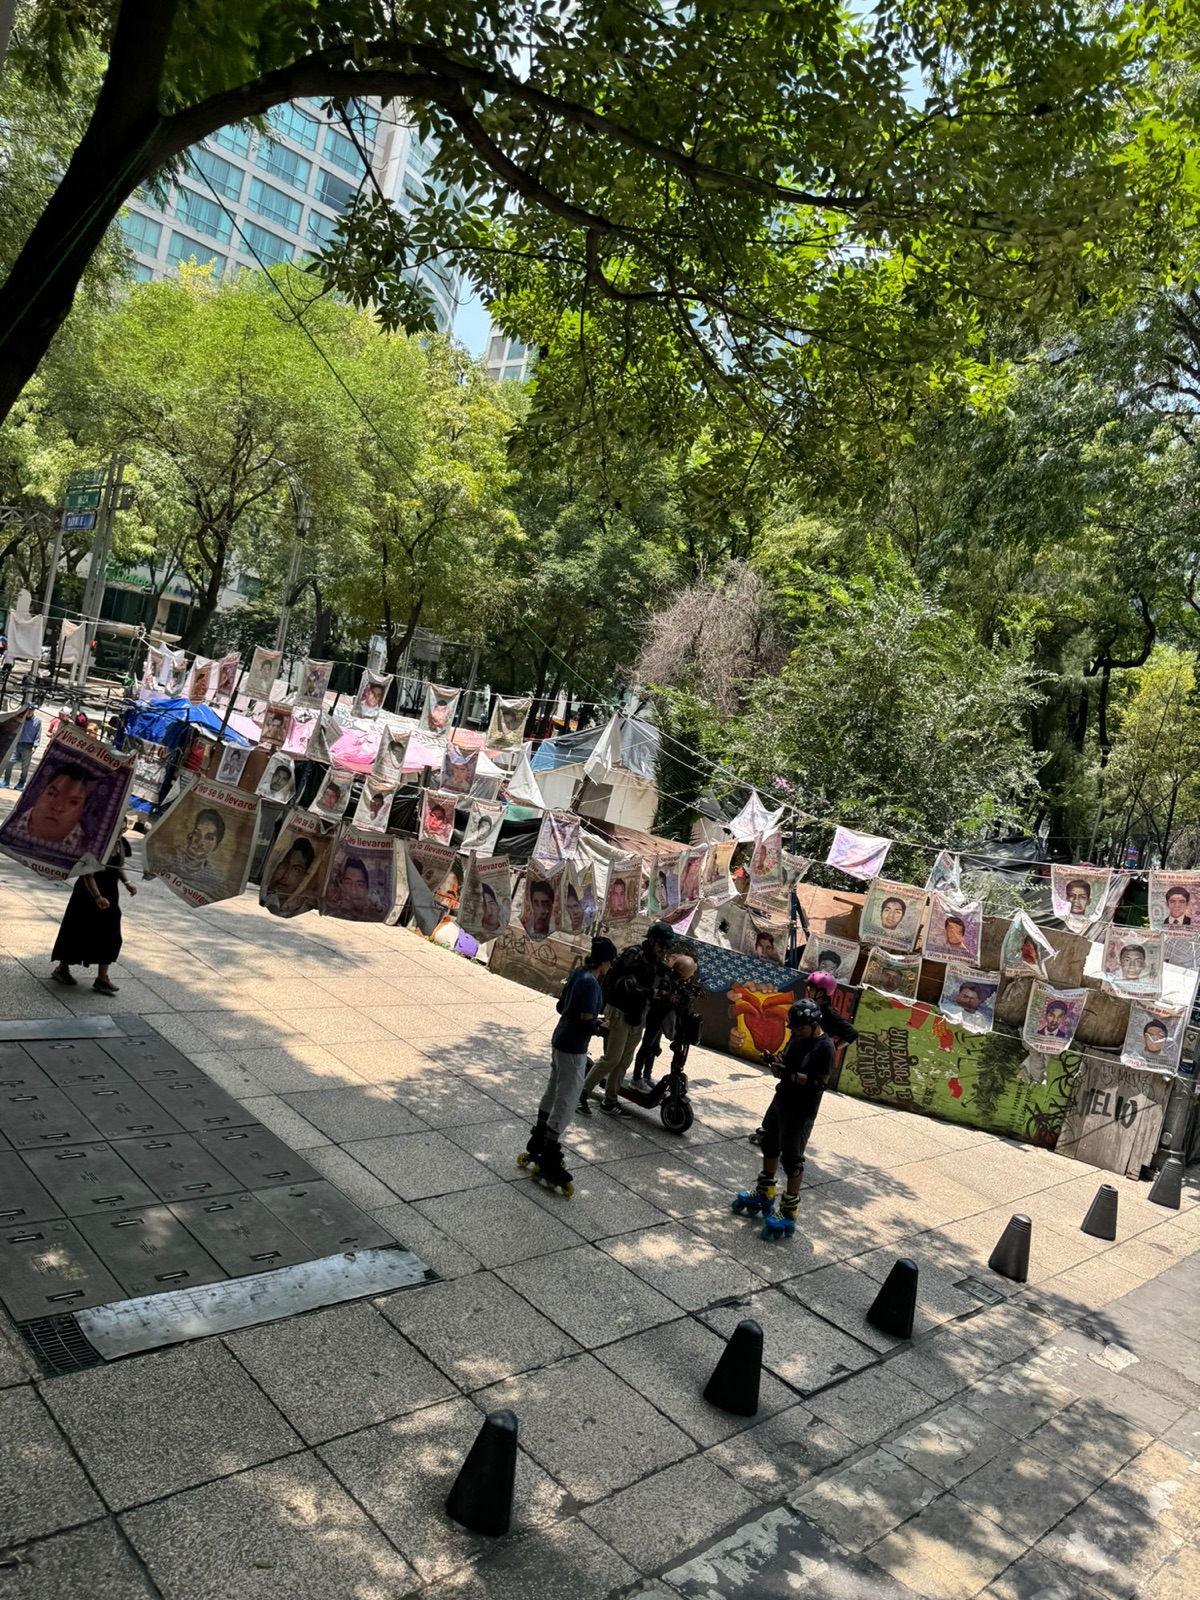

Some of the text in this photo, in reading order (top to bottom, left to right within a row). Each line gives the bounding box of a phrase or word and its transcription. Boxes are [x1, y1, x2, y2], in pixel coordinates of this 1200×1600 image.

[55, 730, 77, 745] ¡Vivo
[76, 740, 86, 749] se
[85, 743, 94, 753] lo
[209, 788, 217, 797] se
[217, 790, 225, 800] lo
[359, 838, 393, 849] llevaron!
[424, 843, 455, 858] llevaron!
[477, 860, 509, 872] llevaron!
[858, 1031, 881, 1096] SOCIALISTA
[889, 1027, 913, 1100] EL PORVENIR
